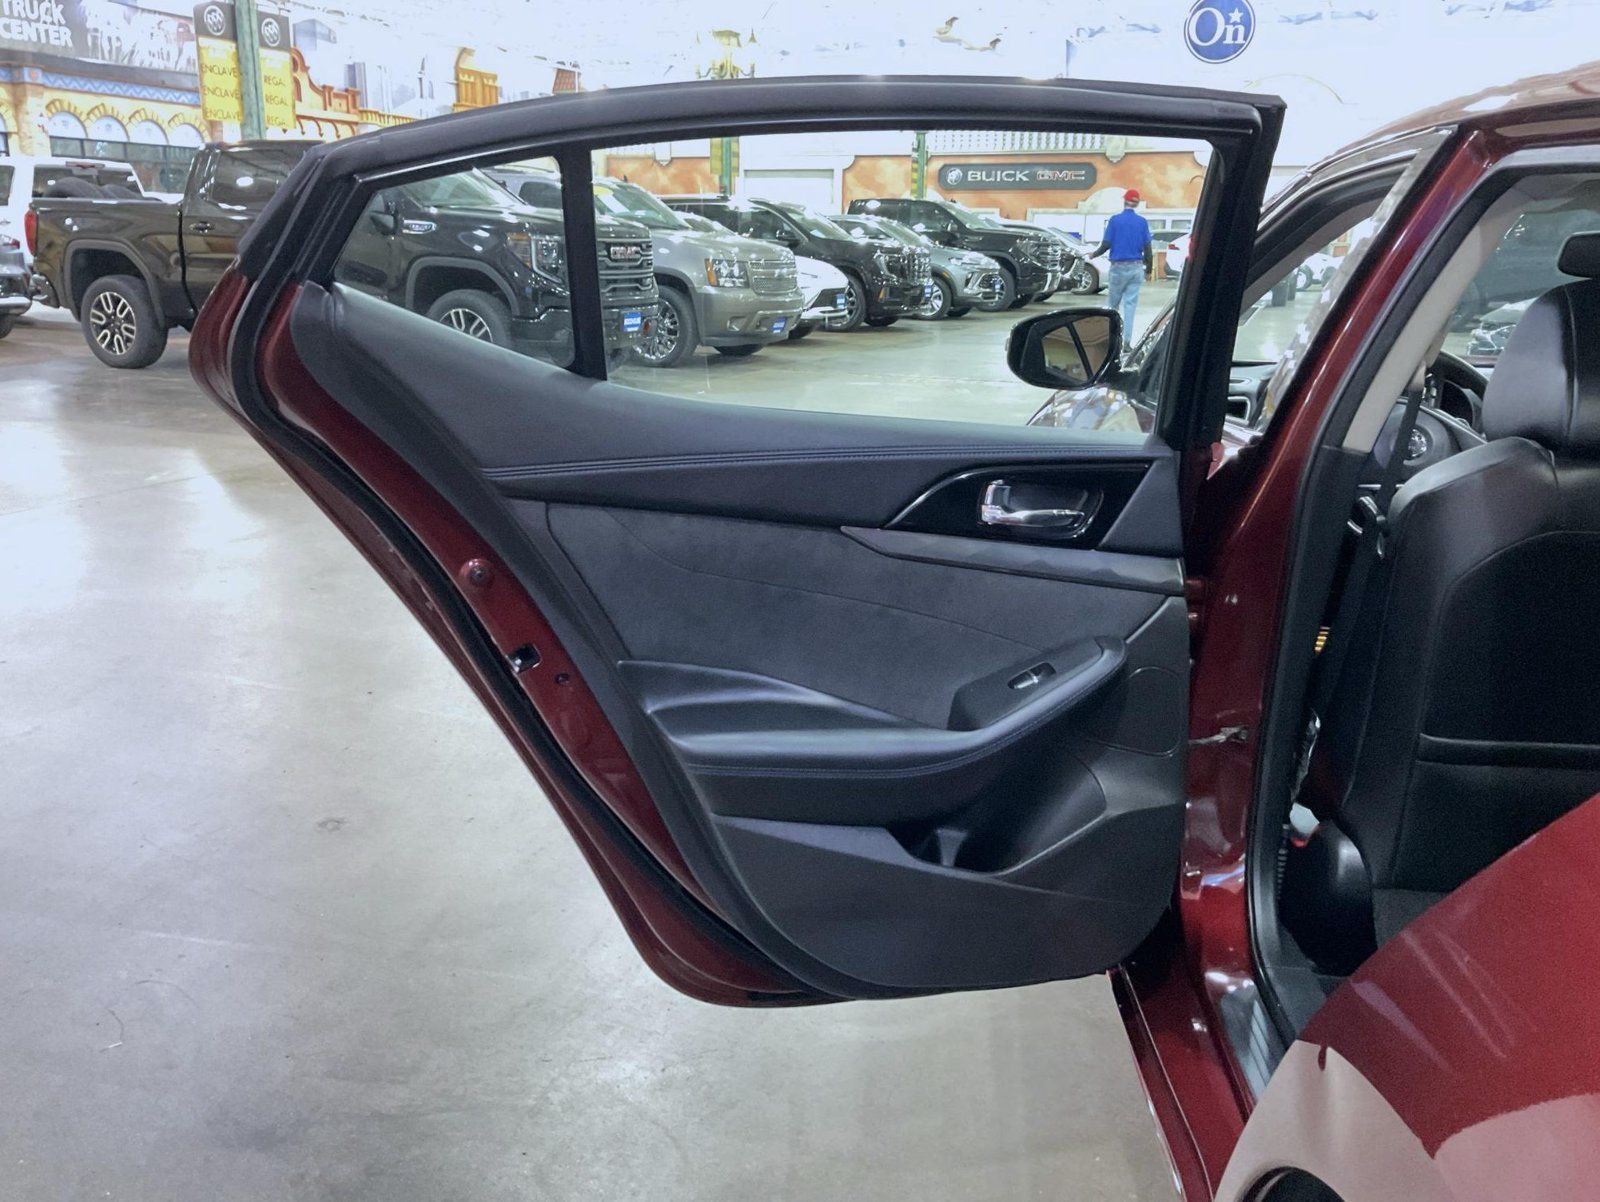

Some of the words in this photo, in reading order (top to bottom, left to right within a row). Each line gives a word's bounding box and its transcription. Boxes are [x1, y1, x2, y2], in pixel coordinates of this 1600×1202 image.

[2, 0, 66, 25] TRUCK
[0, 17, 73, 47] CENTER
[1188, 7, 1246, 46] On
[200, 63, 239, 78] ENCLAVE
[201, 85, 241, 99] ENCLAVE
[204, 108, 242, 121] ENCLAVE
[967, 170, 1030, 182] BUICK
[1037, 170, 1086, 181] GMC
